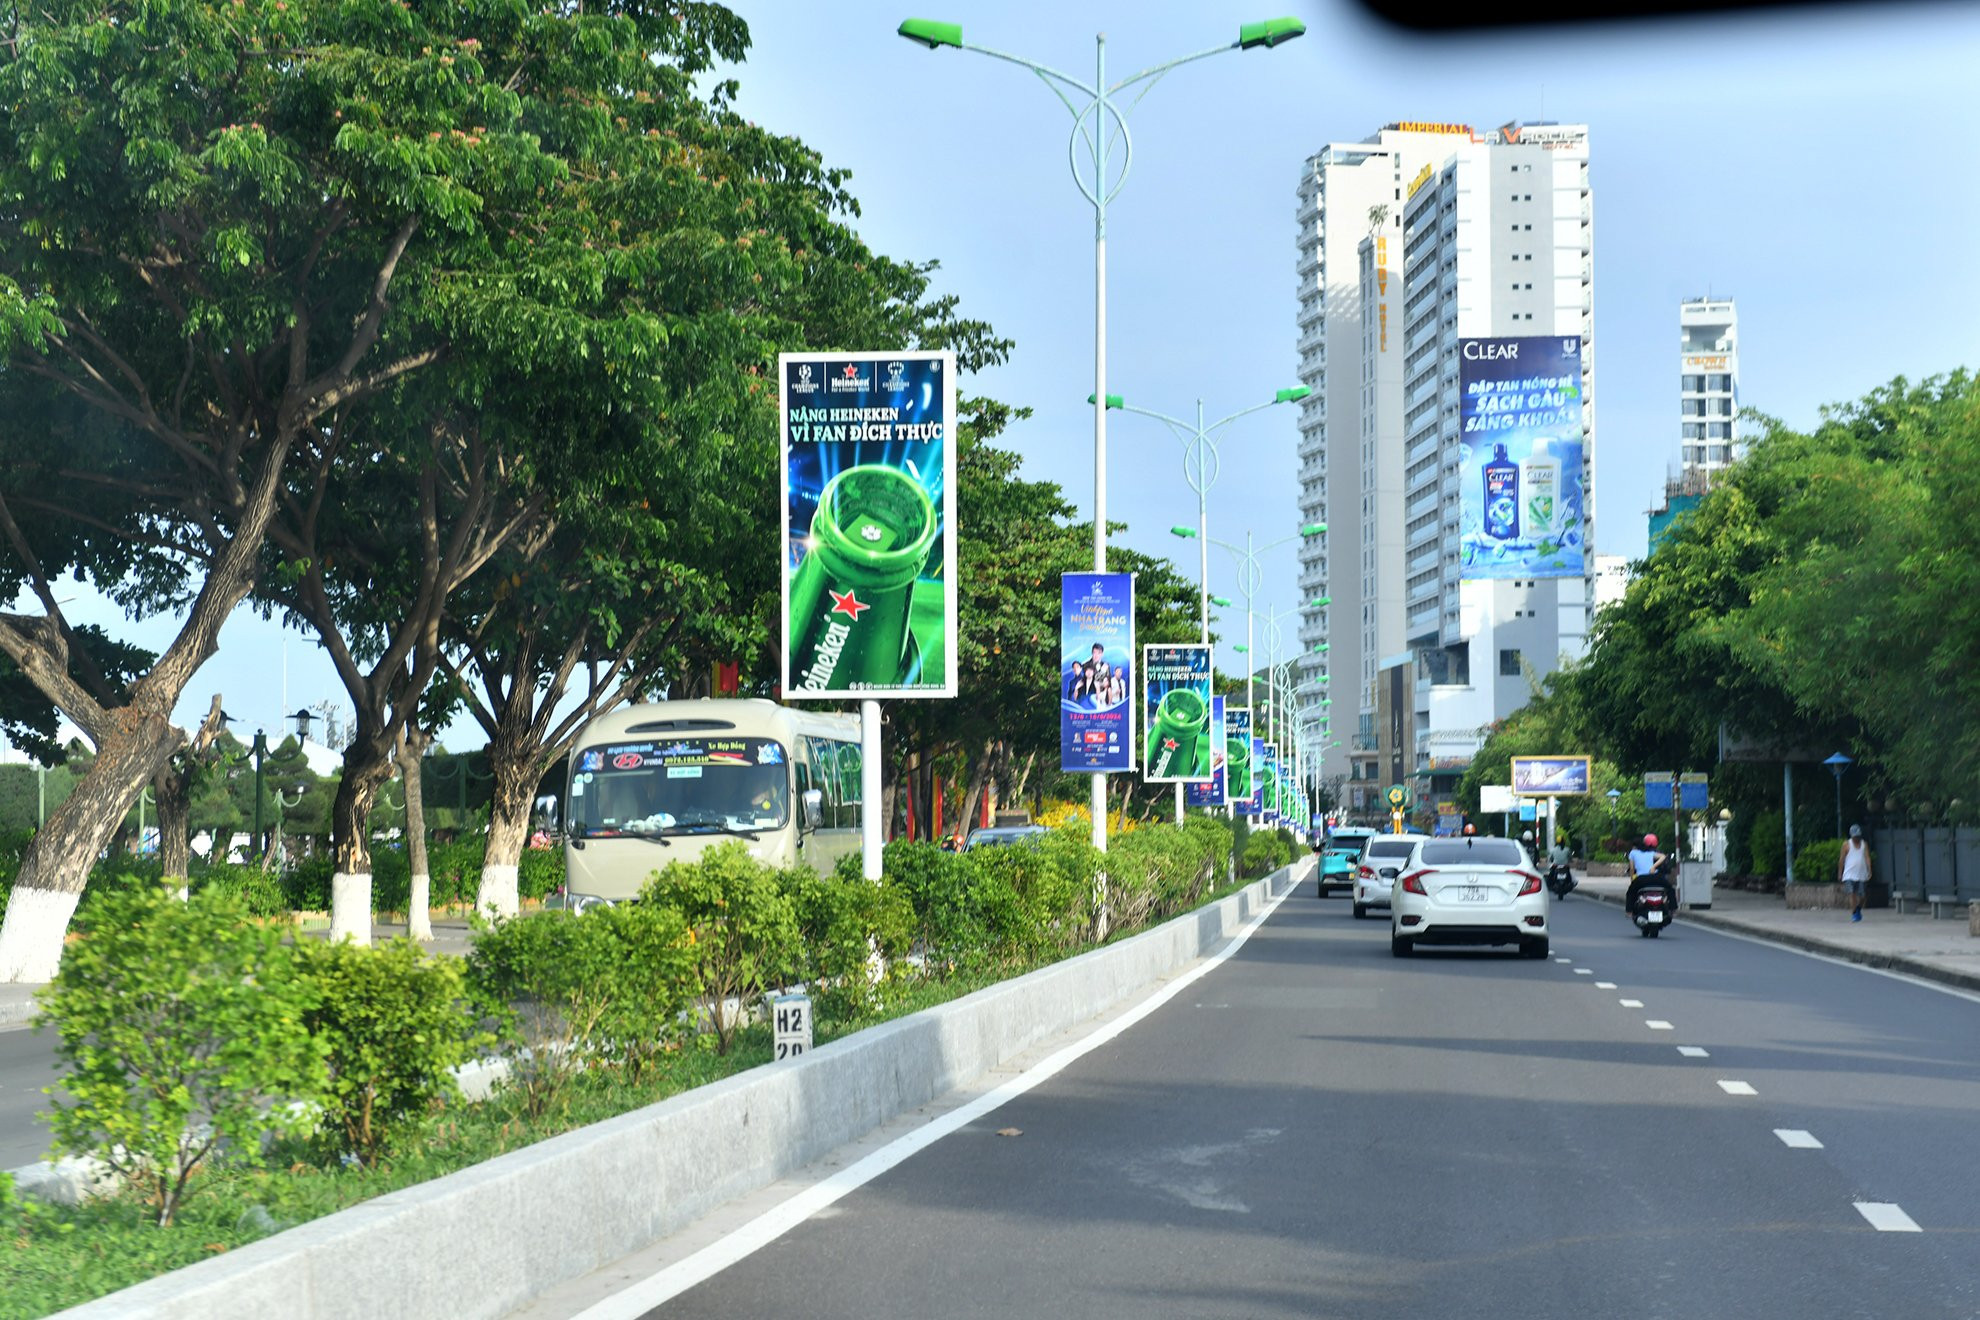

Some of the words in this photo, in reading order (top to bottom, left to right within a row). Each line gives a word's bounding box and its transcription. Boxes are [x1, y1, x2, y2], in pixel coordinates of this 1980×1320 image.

[1400, 121, 1468, 135] IMPERIAL
[1377, 236, 1387, 296] RUBY
[1463, 341, 1519, 360] CLEAR
[831, 376, 870, 388] Heineken
[1496, 380, 1520, 393] TAN
[1522, 376, 1558, 390] NÓNG
[829, 407, 899, 422] HEINEKEN
[790, 422, 810, 442] VÌ
[812, 424, 847, 443] FAN
[849, 420, 892, 442] ĐÍCH
[895, 420, 943, 444] THỰC
[1094, 615, 1127, 625] TRANG
[777, 1008, 803, 1033] H2
